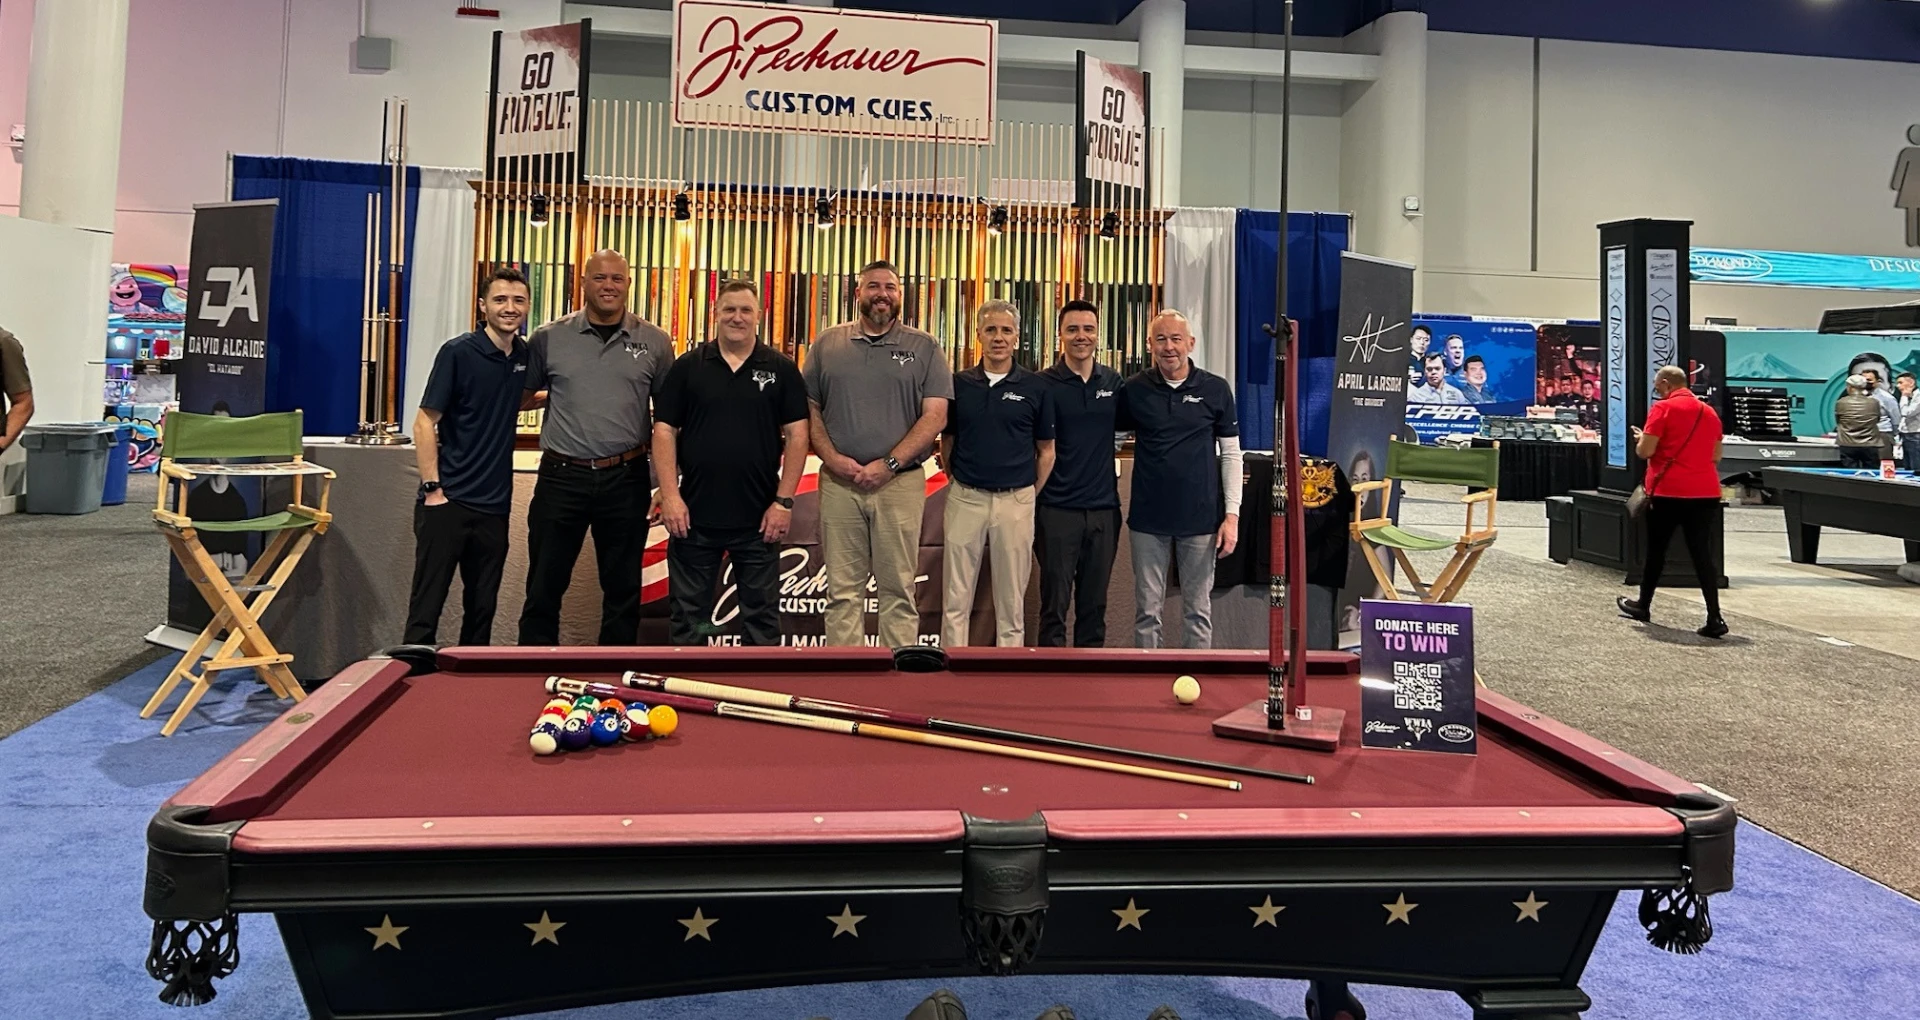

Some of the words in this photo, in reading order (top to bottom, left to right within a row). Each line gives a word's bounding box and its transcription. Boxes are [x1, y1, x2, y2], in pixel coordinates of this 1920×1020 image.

[738, 16, 985, 80] Pechauer
[521, 51, 554, 90] GO
[745, 90, 854, 117] CUSTOM
[867, 99, 933, 121] CUES
[1101, 86, 1126, 123] GO
[1694, 256, 1752, 270] DIAMOND
[188, 336, 219, 355] DAVID
[222, 338, 265, 358] ALCAIDE
[1609, 305, 1624, 402] DIAMOND
[1337, 373, 1364, 390] APRIL
[1368, 375, 1402, 392] LARSON
[779, 598, 827, 614] CUSTO
[1375, 619, 1424, 633] DONATE
[1427, 622, 1459, 635] HERE
[1382, 633, 1406, 650] TO
[1411, 635, 1448, 653] WIN
